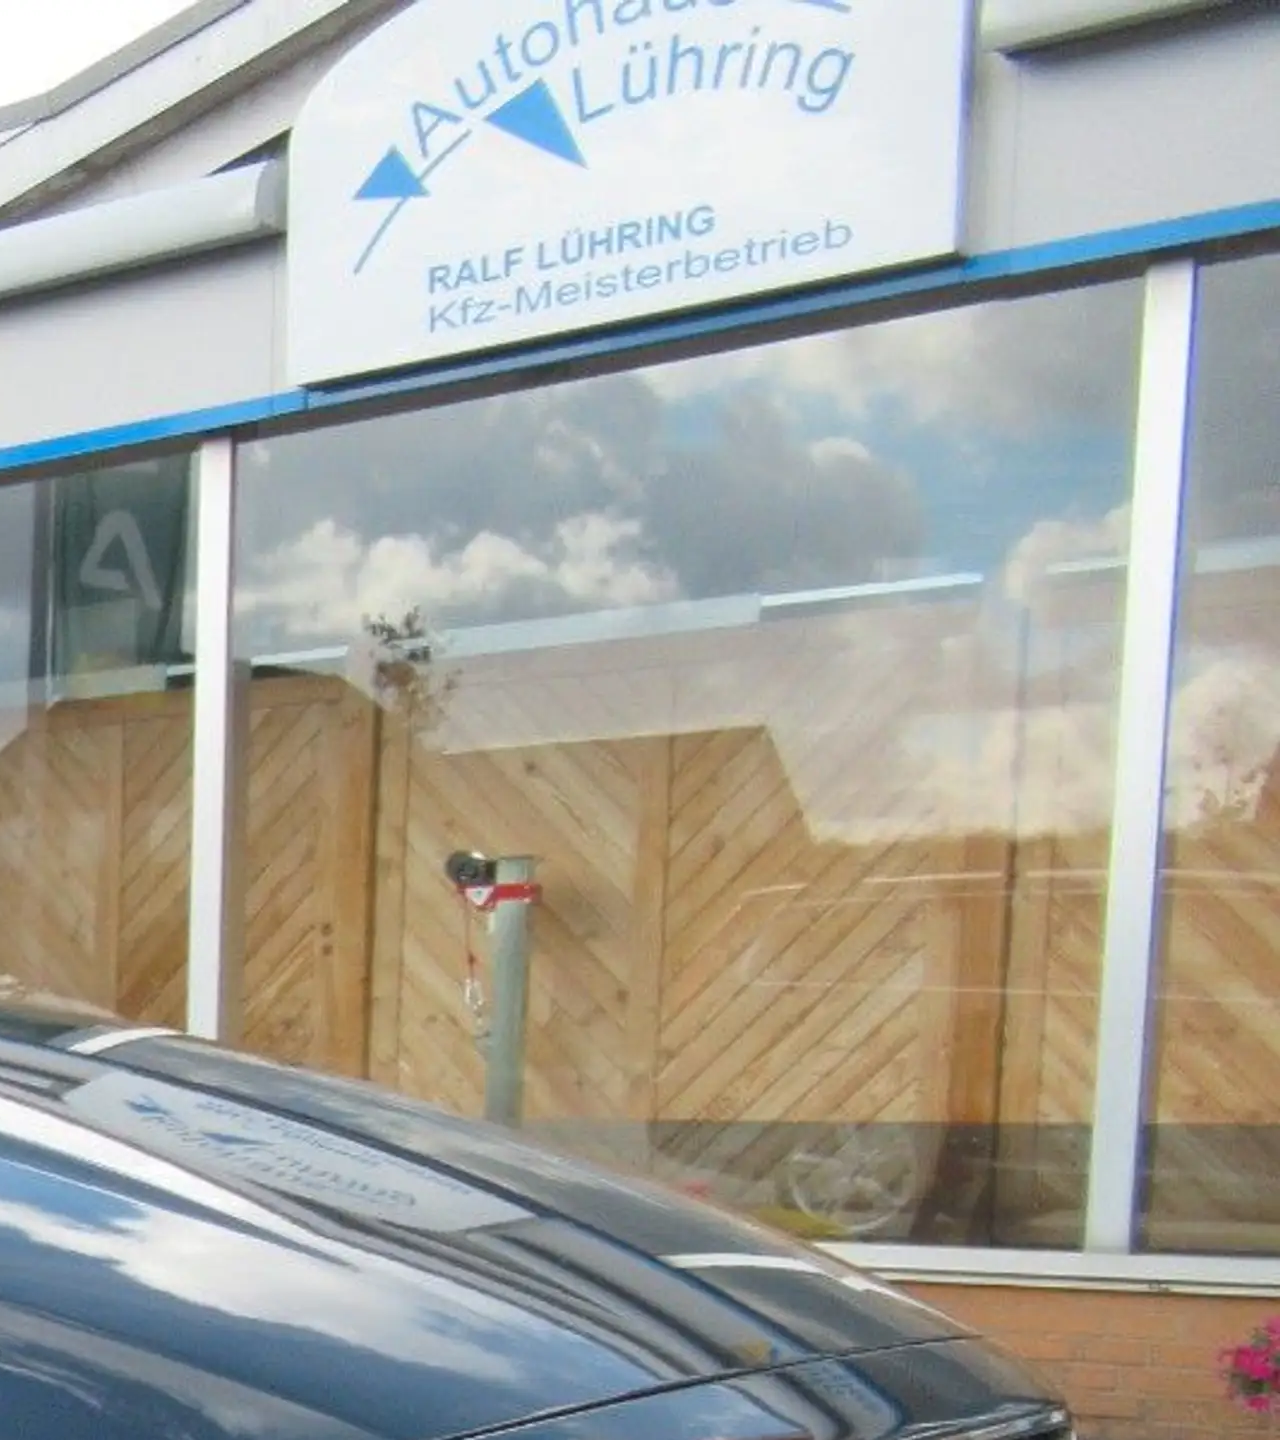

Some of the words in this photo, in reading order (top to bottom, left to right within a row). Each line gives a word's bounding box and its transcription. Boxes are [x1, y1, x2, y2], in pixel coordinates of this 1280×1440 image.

[409, 0, 734, 158] Autoha
[572, 26, 856, 123] Lühring
[427, 218, 853, 333] Kfz-Meisterbetrieb
[428, 246, 523, 294] RALF
[536, 205, 716, 269] LÜHRING
